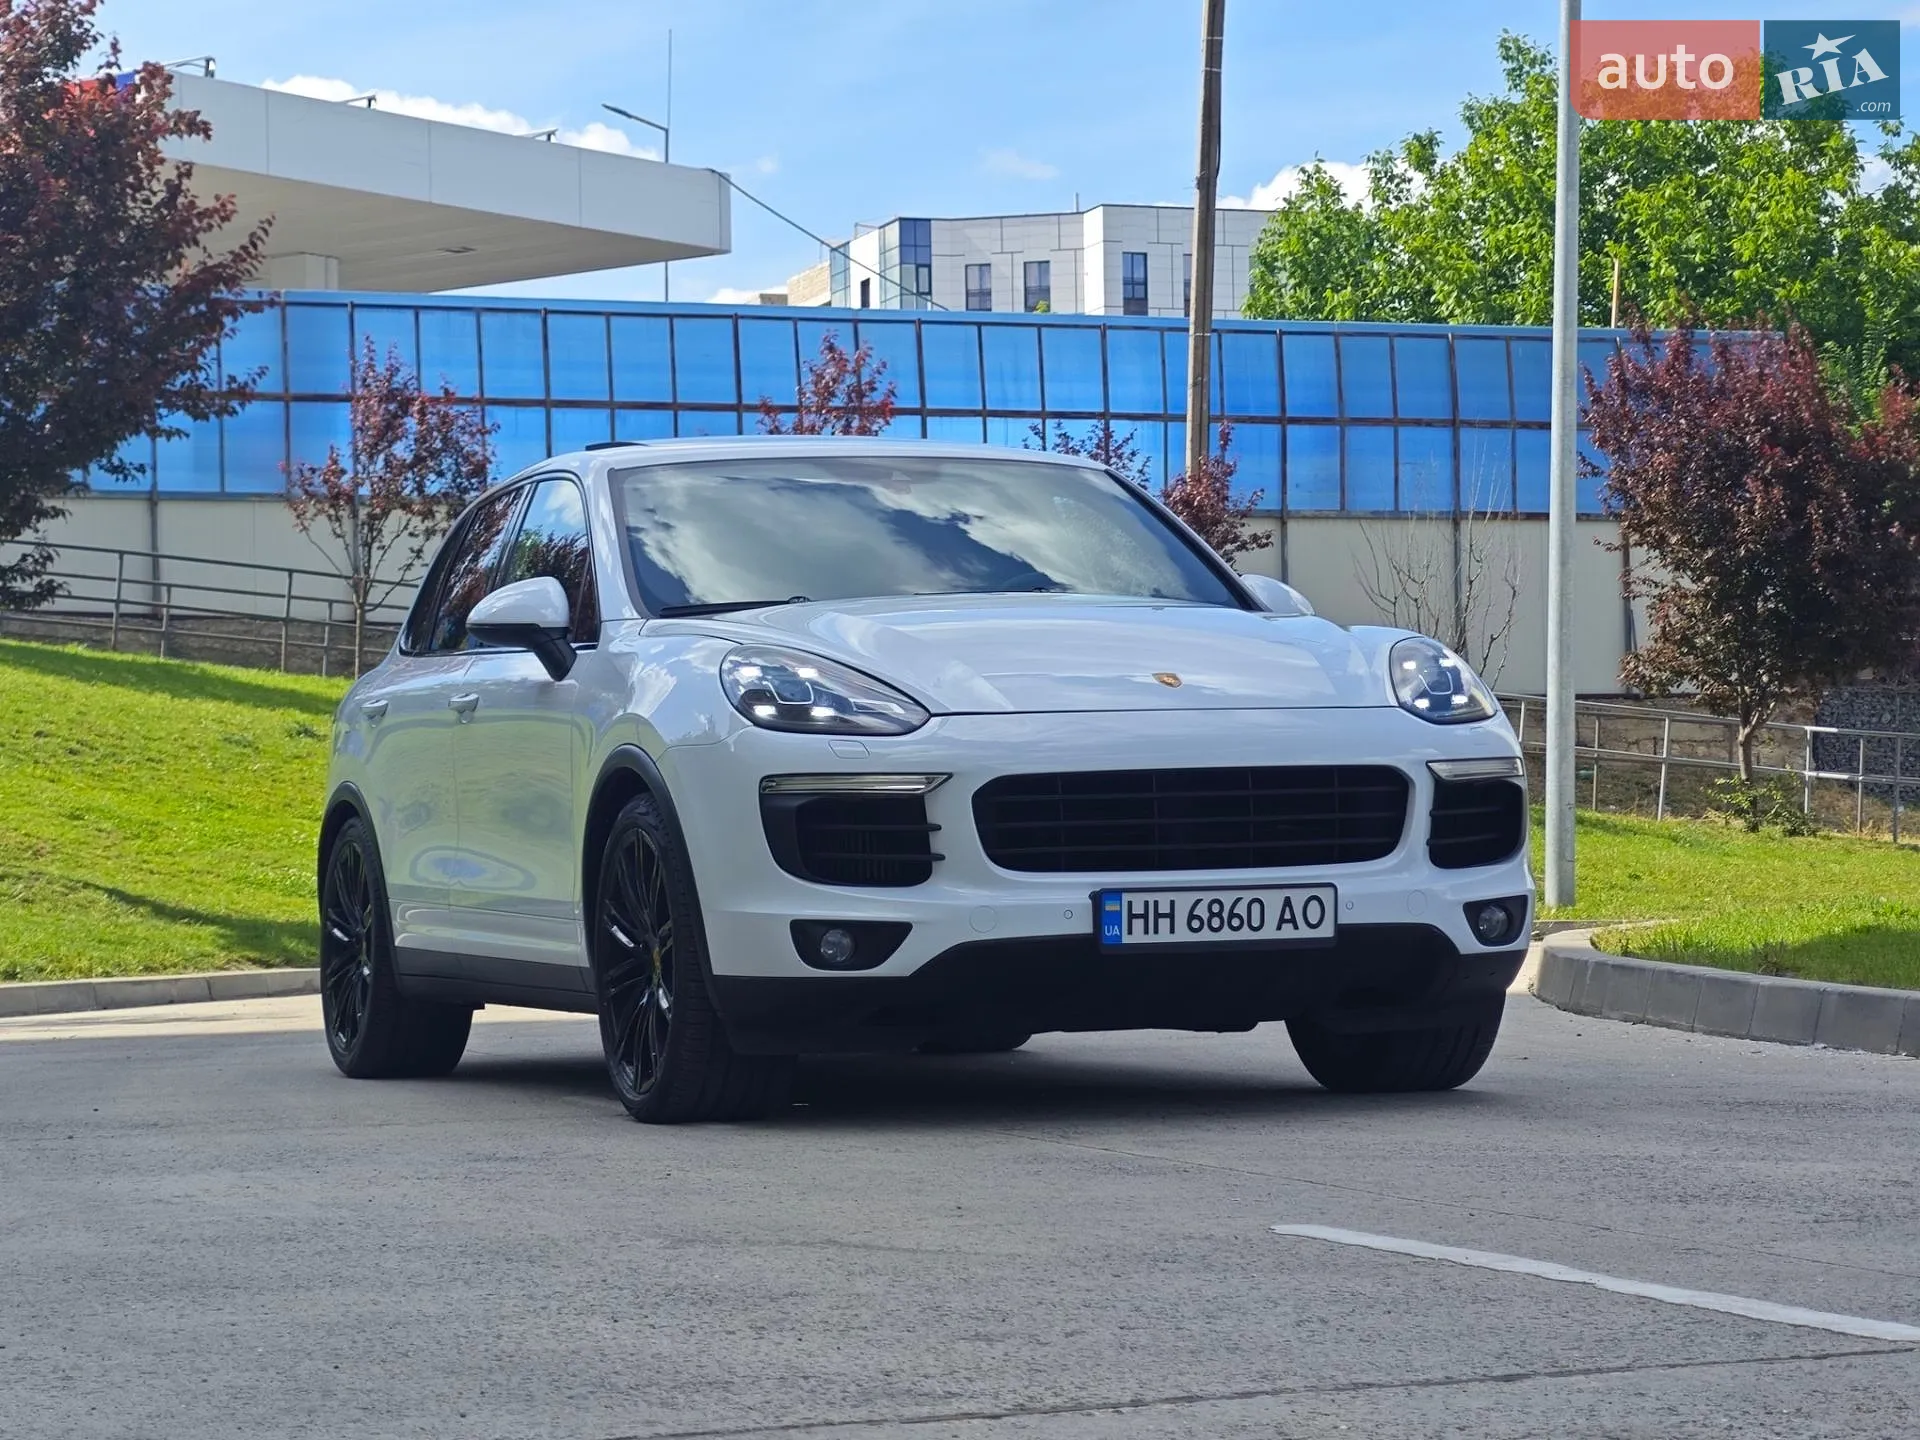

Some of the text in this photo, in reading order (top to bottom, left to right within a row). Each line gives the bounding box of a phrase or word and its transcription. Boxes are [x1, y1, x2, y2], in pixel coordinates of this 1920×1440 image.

[1127, 894, 1326, 935] HH 6860 AO
[1104, 925, 1121, 936] UA
